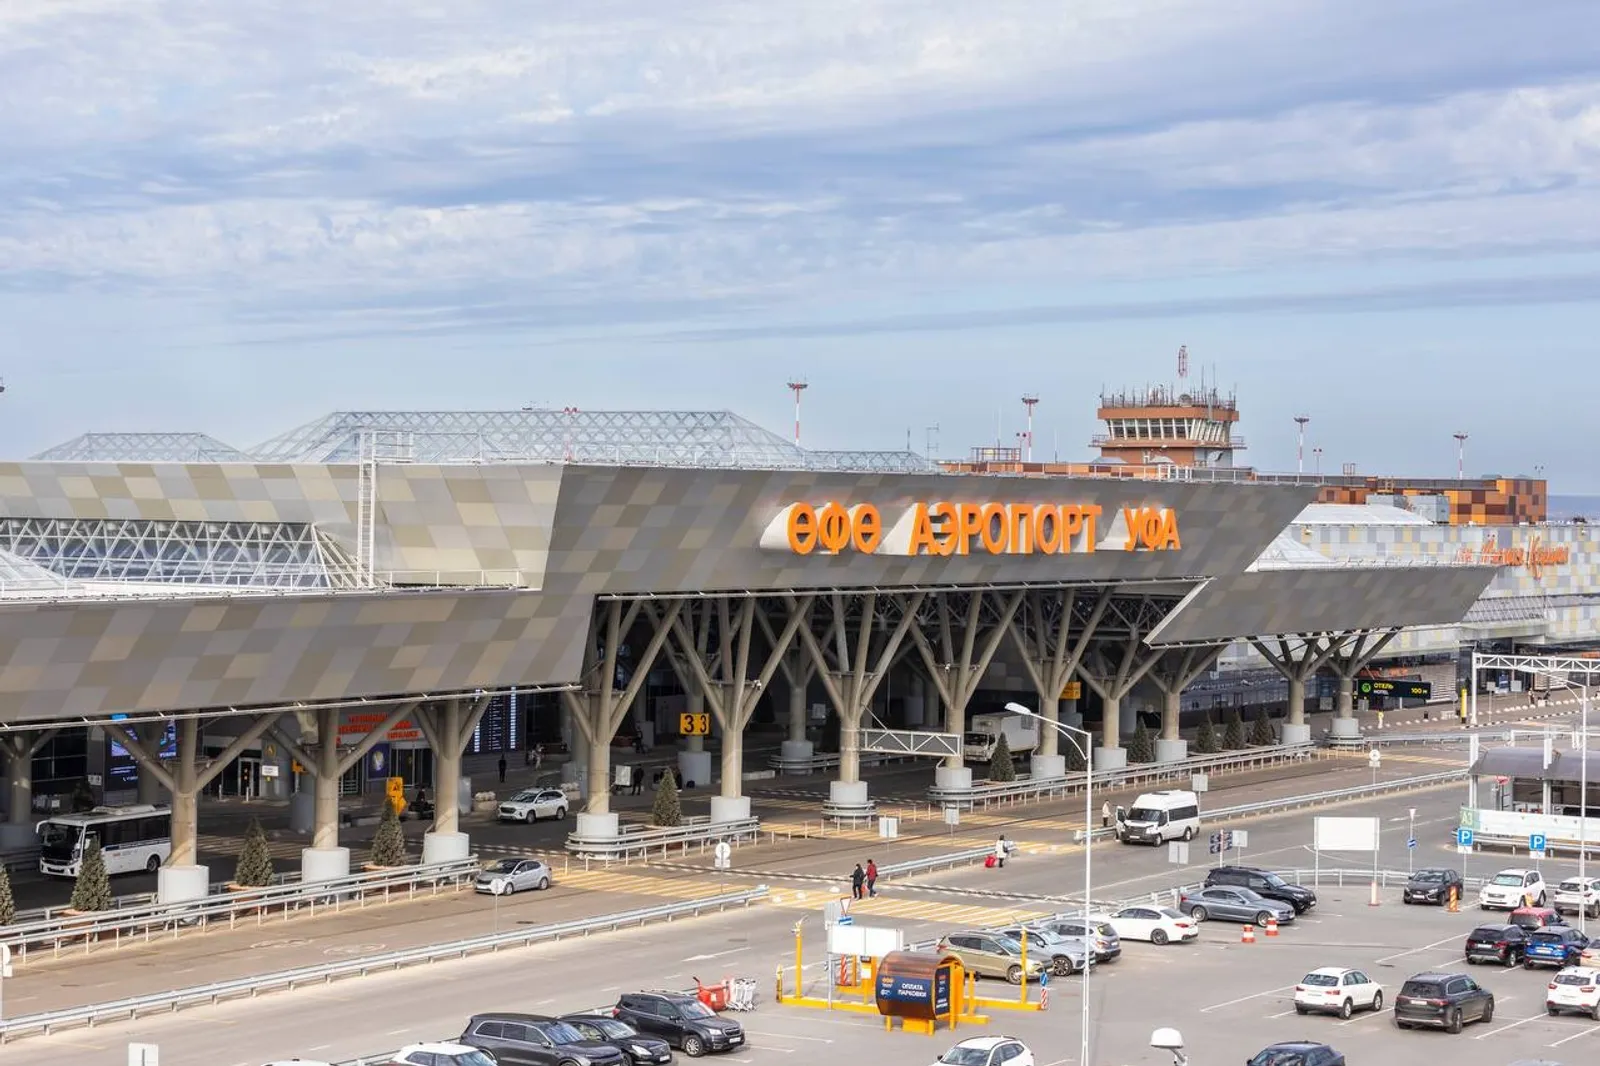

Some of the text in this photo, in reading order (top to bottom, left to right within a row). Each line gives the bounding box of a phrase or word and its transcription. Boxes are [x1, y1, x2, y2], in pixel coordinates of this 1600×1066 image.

[787, 501, 1181, 556] ӨФӨ АЭРОПОРТ УФА
[684, 715, 707, 732] 3 3
[1461, 830, 1470, 843] P
[1533, 836, 1543, 848] P
